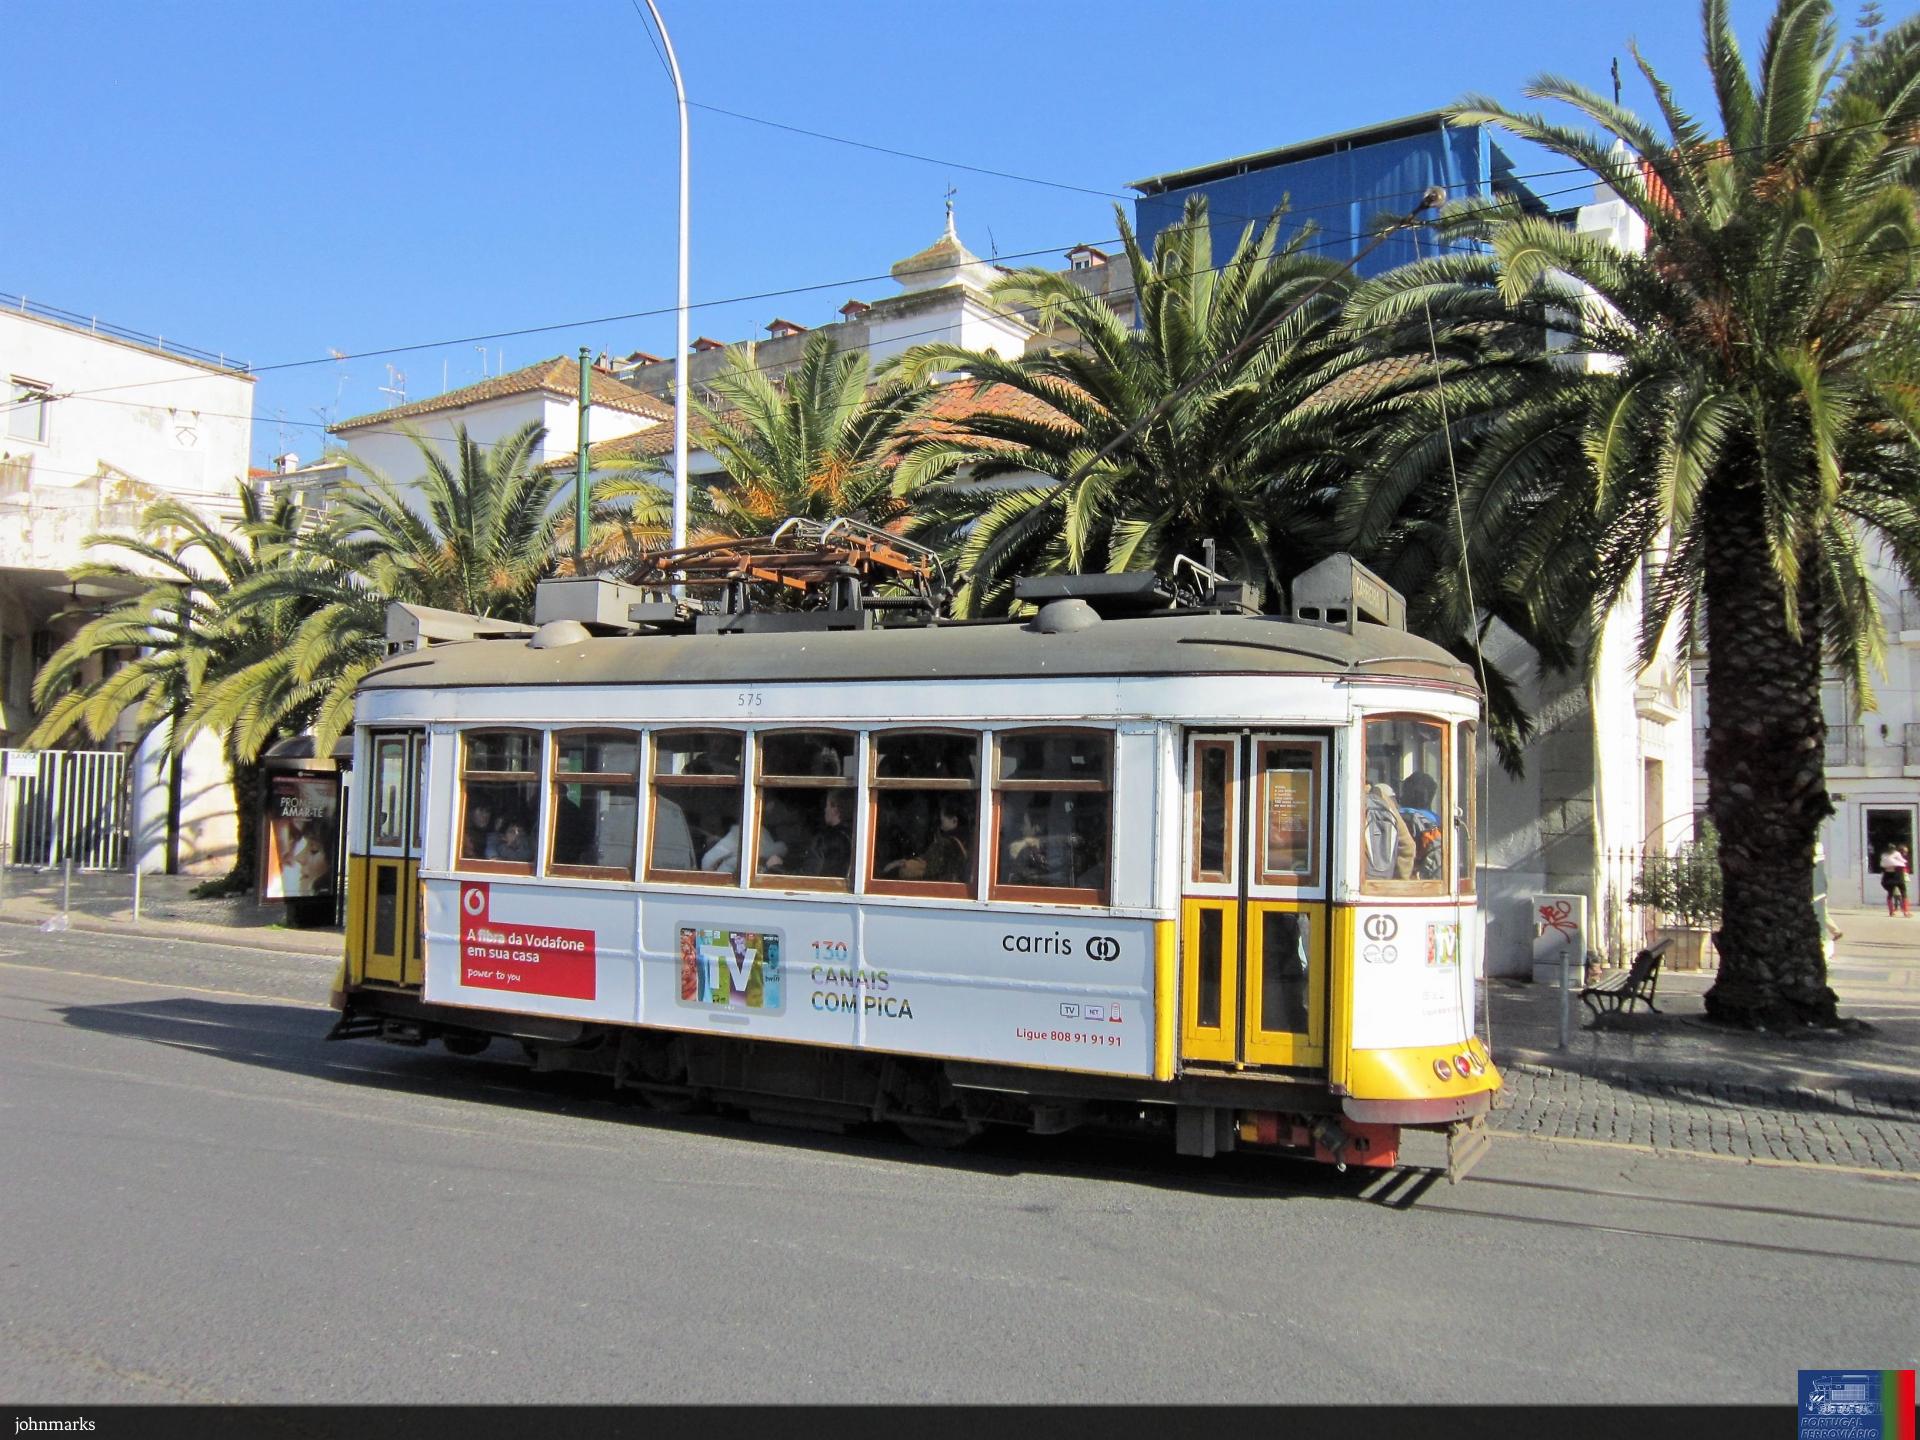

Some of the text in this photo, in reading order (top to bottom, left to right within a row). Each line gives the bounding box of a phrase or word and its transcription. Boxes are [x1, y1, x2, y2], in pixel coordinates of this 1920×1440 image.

[738, 693, 762, 706] 575
[467, 929, 476, 942] A
[508, 933, 522, 946] da
[525, 934, 585, 951] Vodafone
[812, 940, 848, 961] 130
[1002, 931, 1072, 955] carris
[467, 946, 539, 963] em sua casa
[467, 969, 520, 984] power to you
[700, 944, 757, 991] TV
[811, 965, 889, 990] CANAIS
[811, 991, 913, 1019] COM PICA
[1065, 1006, 1075, 1014] TV
[1016, 1027, 1121, 1046] Ligue 808 91 91 91
